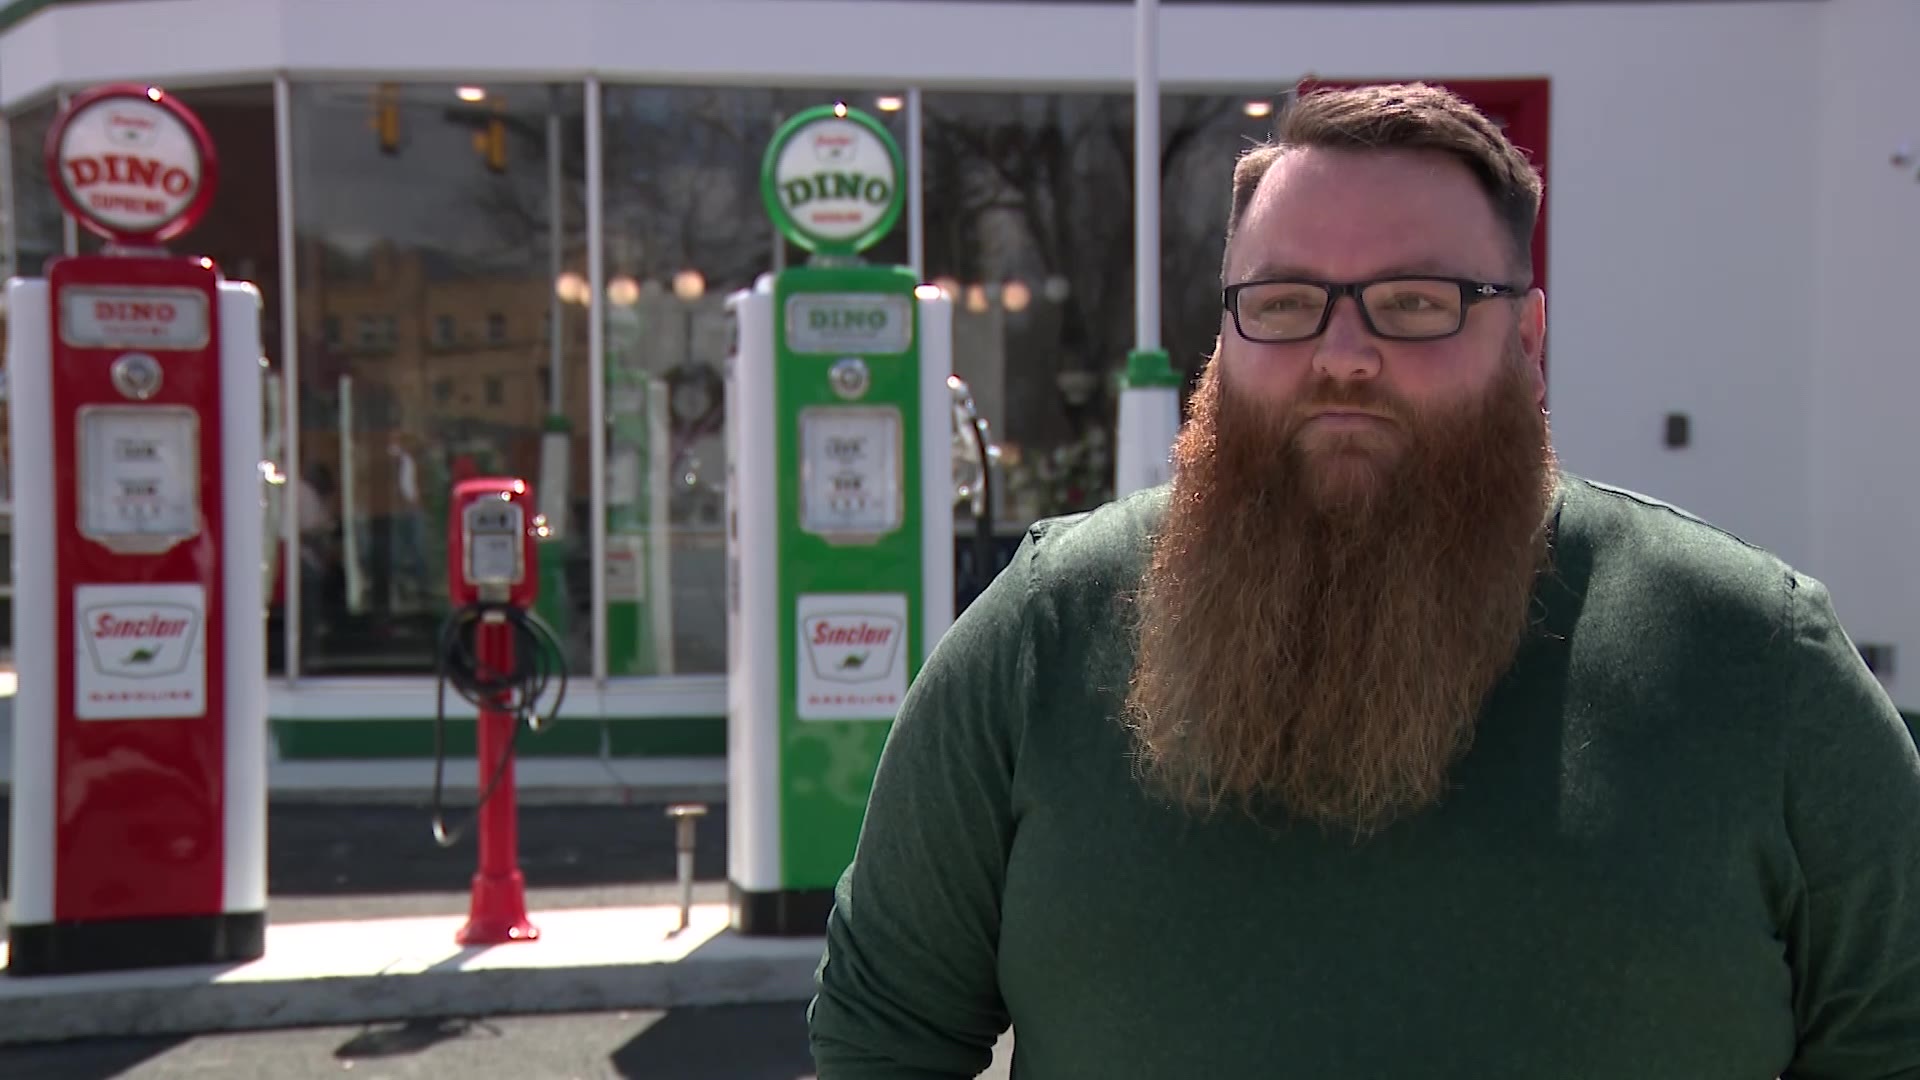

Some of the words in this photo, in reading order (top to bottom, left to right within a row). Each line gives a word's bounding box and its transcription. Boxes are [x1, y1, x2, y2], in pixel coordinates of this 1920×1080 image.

[67, 154, 191, 196] DINO
[784, 171, 888, 206] DINO
[95, 301, 176, 323] DINO
[809, 308, 887, 331] DINO
[95, 612, 188, 639] Sinclair
[814, 621, 892, 645] Sinclair
